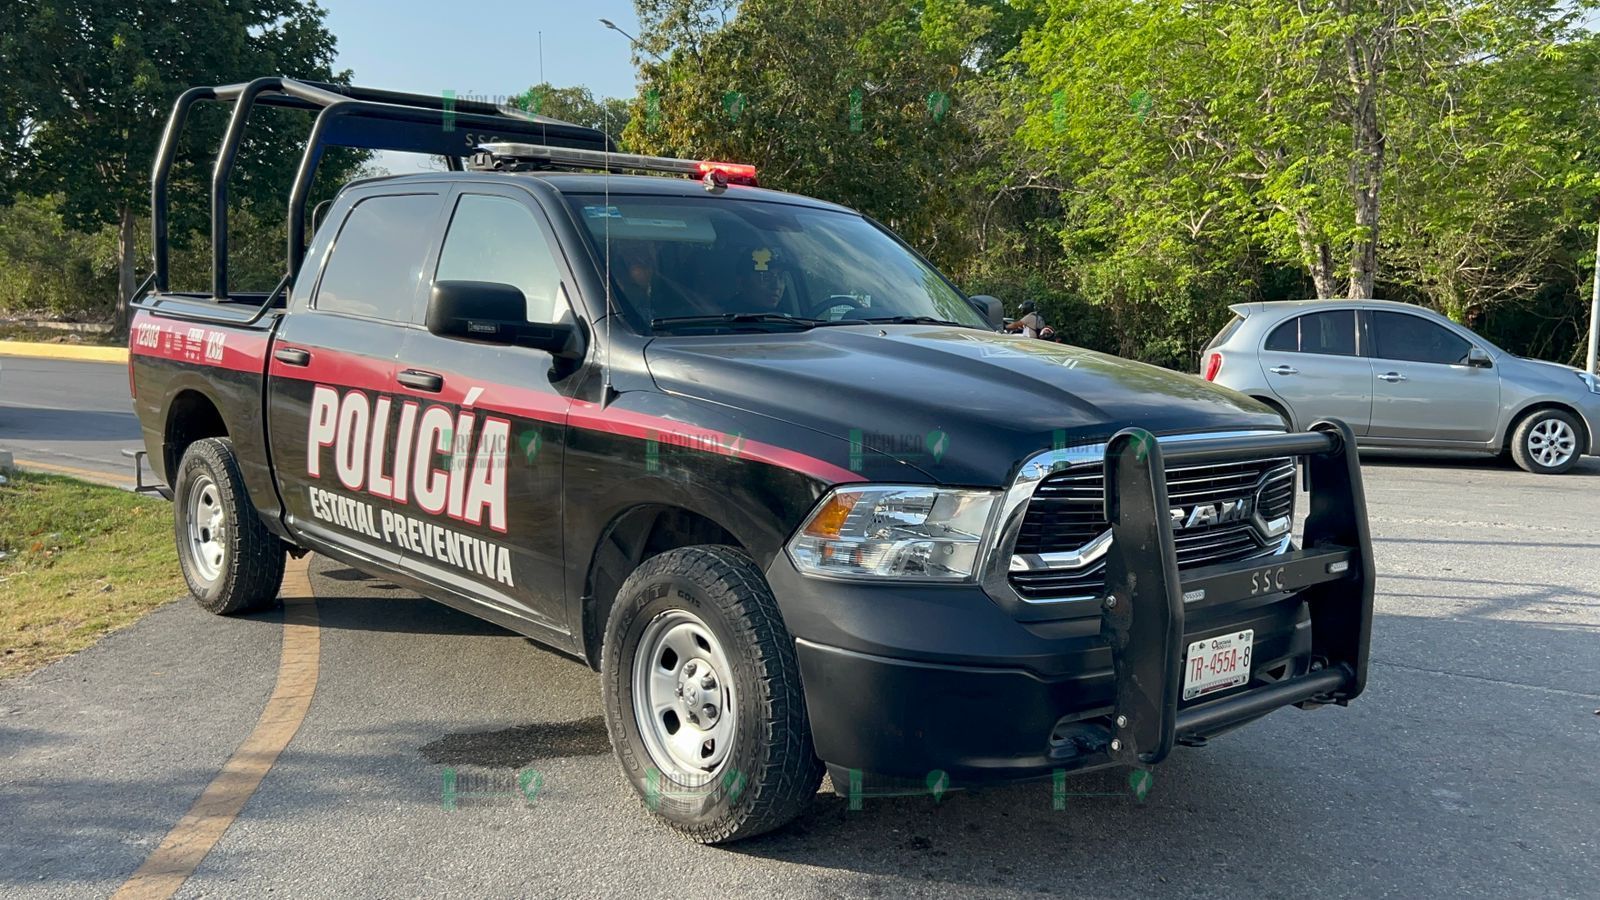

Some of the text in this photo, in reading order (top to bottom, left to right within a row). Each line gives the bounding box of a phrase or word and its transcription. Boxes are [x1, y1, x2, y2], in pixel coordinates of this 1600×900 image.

[307, 383, 512, 534] POLICÍA
[309, 486, 514, 587] ESTATAL PREVENTIVA
[1251, 567, 1284, 594] SSC
[1191, 646, 1250, 682] TR-455A-8
